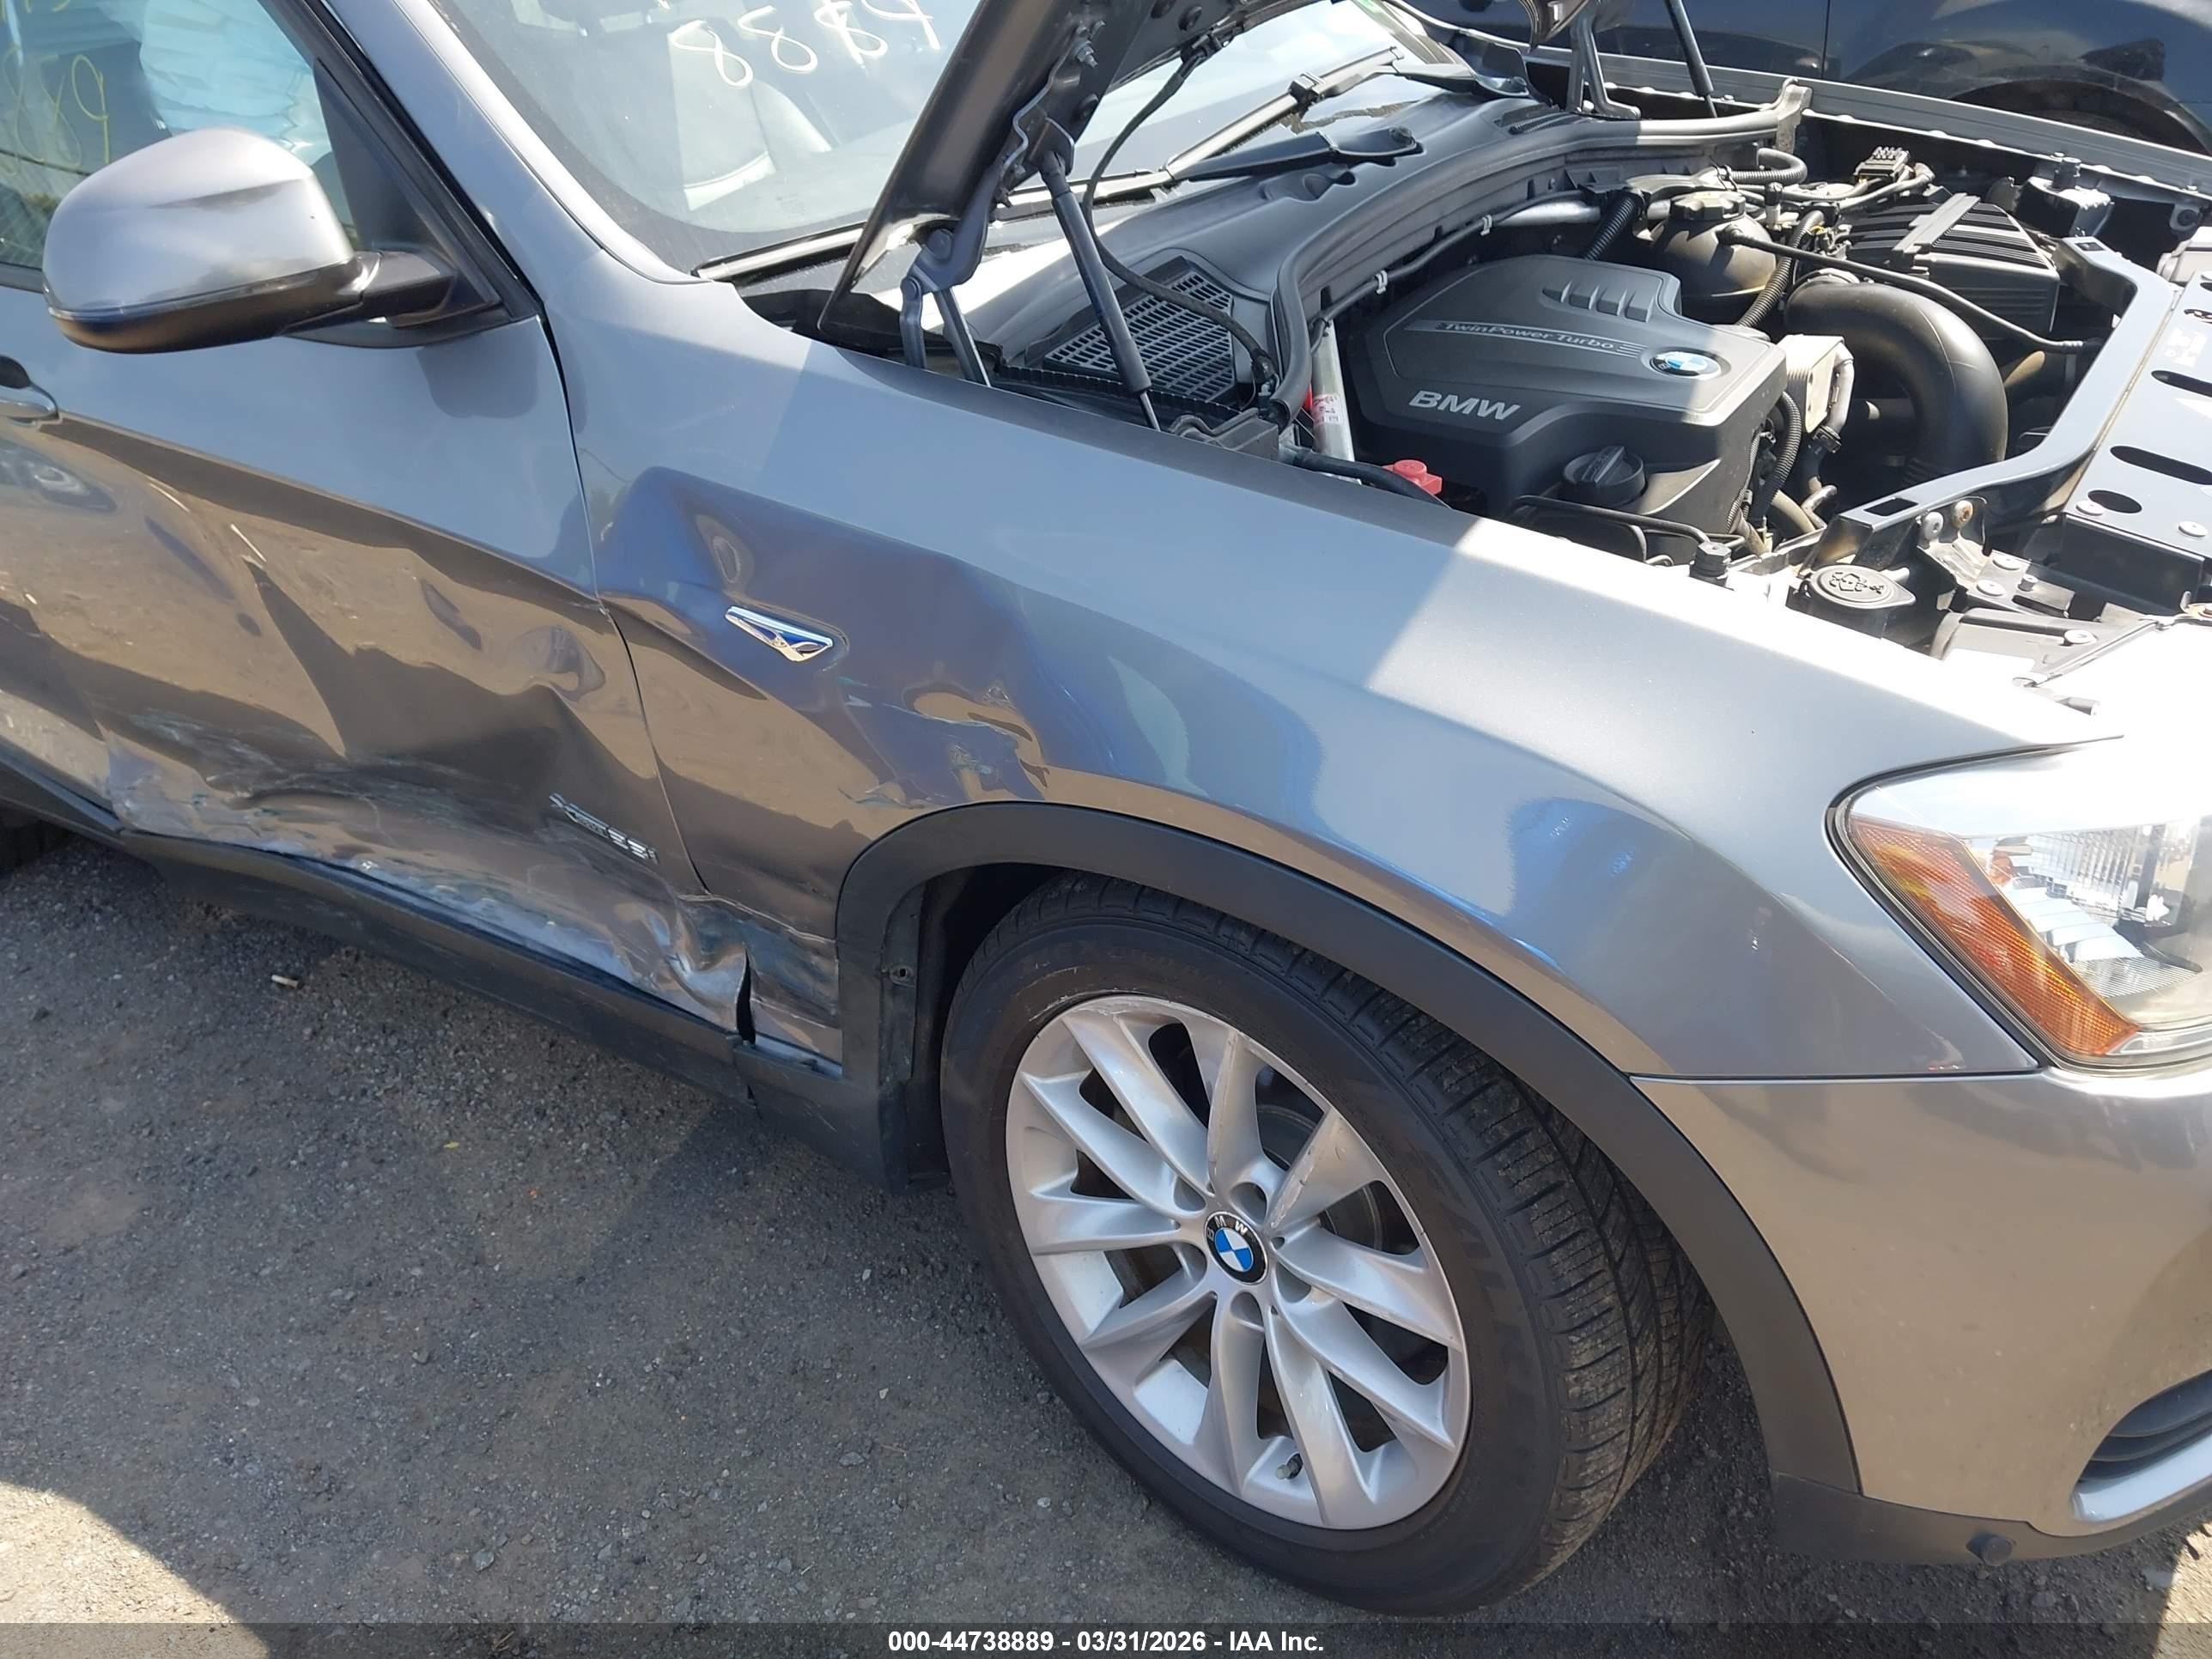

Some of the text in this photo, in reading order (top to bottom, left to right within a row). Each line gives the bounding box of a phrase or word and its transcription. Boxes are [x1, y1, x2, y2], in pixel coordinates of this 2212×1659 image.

[1444, 322, 1614, 349] TwinPower Turbo
[1408, 389, 1521, 420] BMW
[1206, 1215, 1249, 1243] BMW
